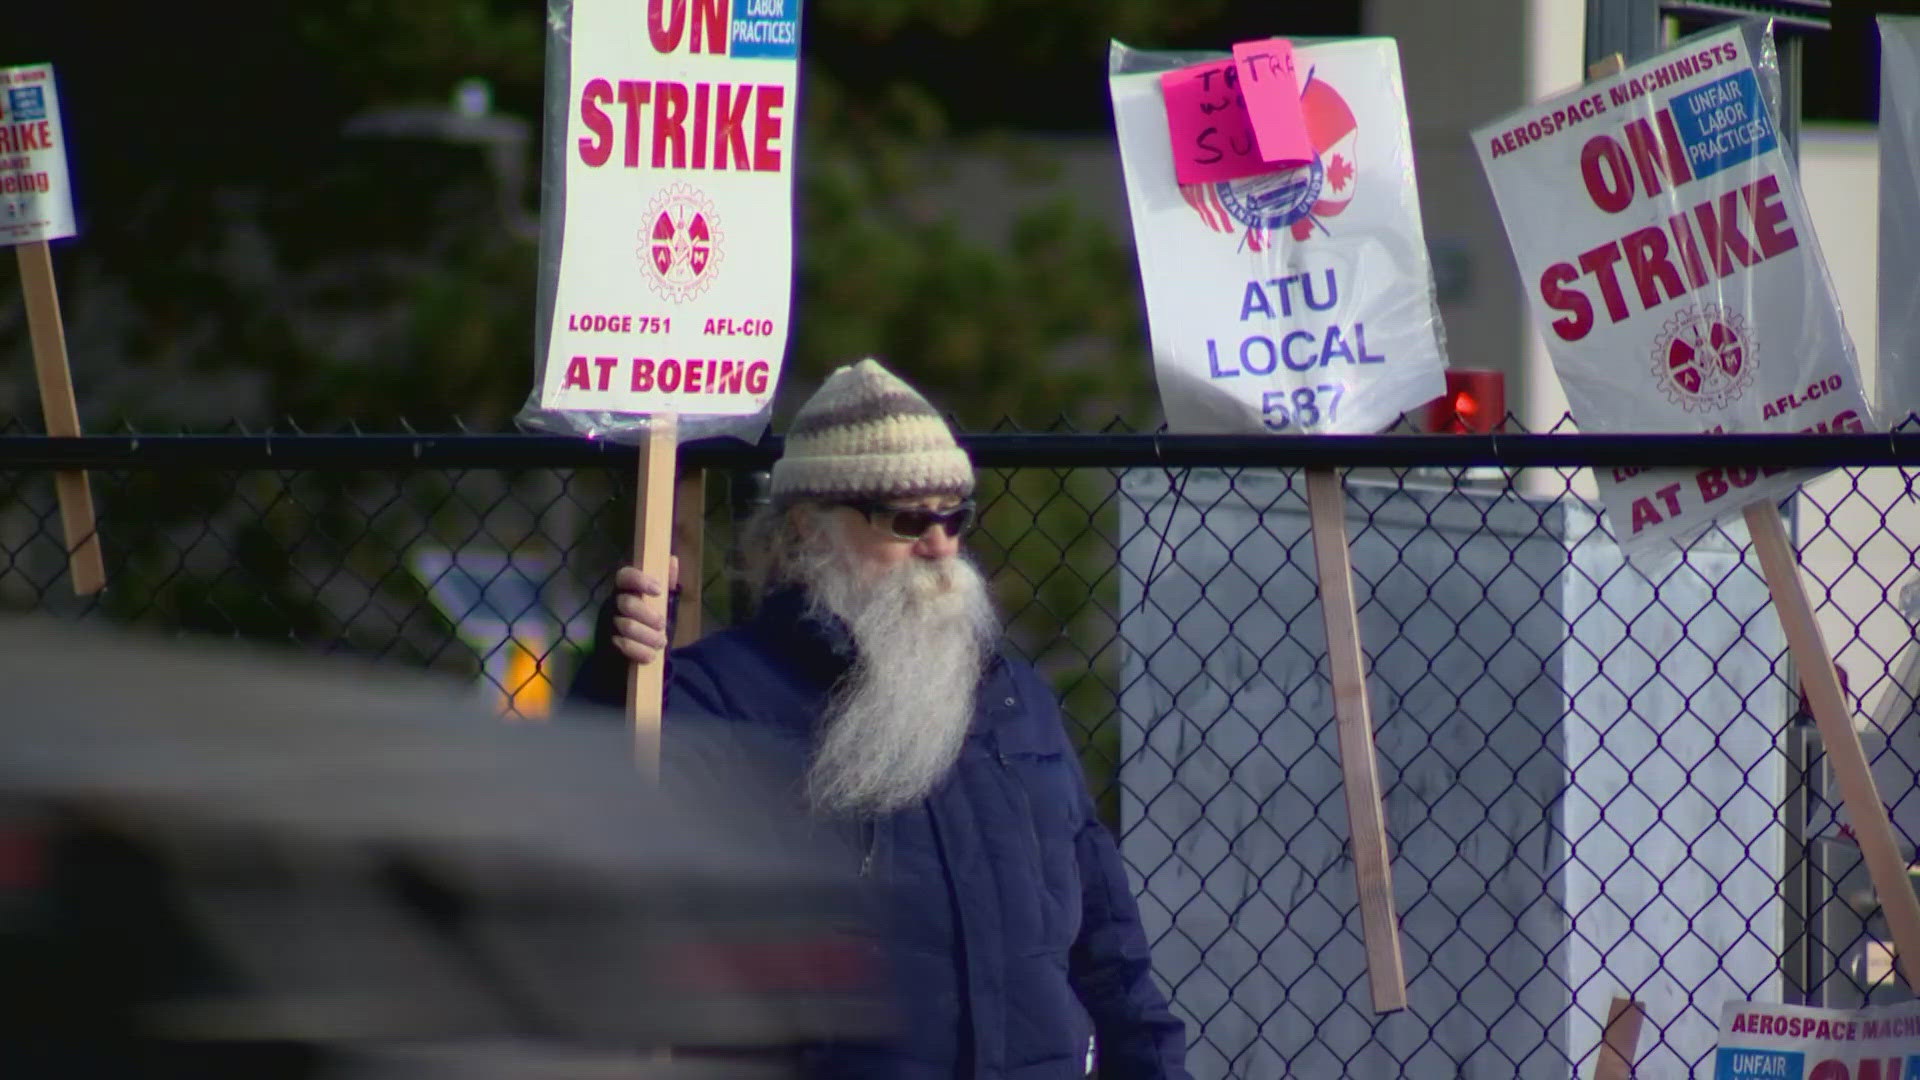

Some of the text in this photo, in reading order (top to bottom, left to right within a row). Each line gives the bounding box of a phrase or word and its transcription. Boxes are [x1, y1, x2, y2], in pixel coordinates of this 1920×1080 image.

[647, 0, 728, 54] ON
[732, 20, 796, 44] PRACTICES!
[747, 0, 784, 17] LABOR
[1490, 42, 1738, 159] AEROSPACE MACHINISTS
[1688, 80, 1743, 115] UNFAIR
[1698, 103, 1748, 137] LABOR
[578, 78, 784, 172] STRIKE
[1689, 116, 1771, 164] PRACTICES!
[1580, 107, 1693, 214] ON
[1540, 174, 1799, 342] STRIKE
[1240, 268, 1338, 321] ATU
[568, 314, 671, 334] LODGE 751
[703, 318, 774, 337] AFL-CIO
[1206, 323, 1385, 378] LOCAL
[565, 356, 769, 394] AT BOEING
[1762, 374, 1842, 421] AFL-CIO
[1262, 384, 1345, 431] 587
[1631, 482, 1683, 534] AT
[1731, 1013, 1857, 1041] AEROSPACE
[1732, 1053, 1786, 1075] UNFAIR
